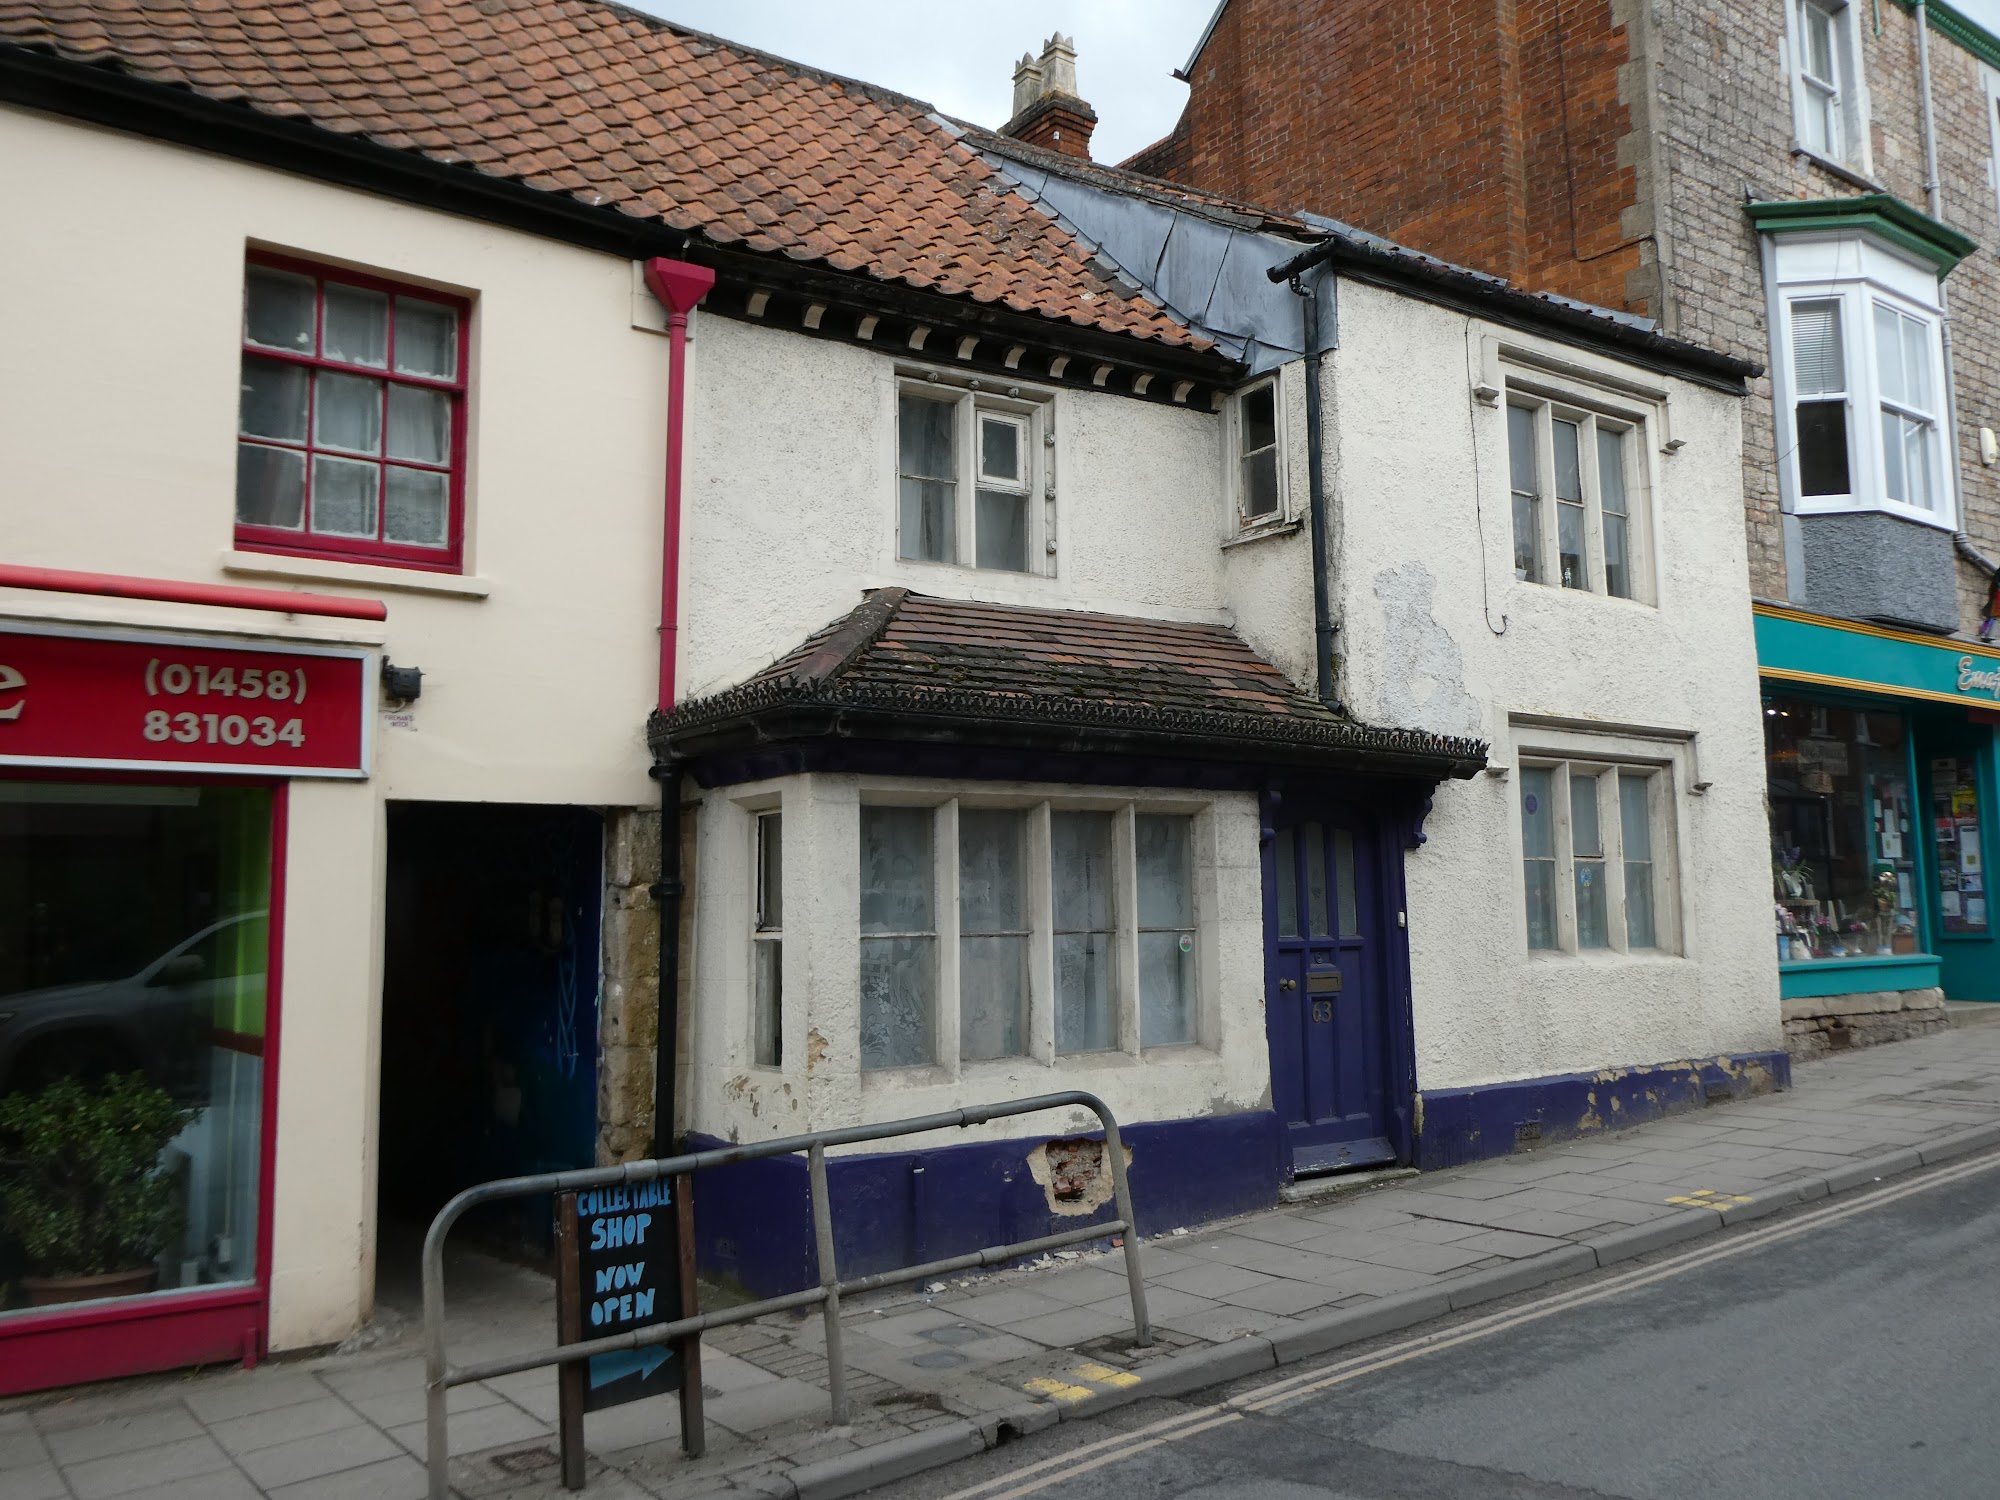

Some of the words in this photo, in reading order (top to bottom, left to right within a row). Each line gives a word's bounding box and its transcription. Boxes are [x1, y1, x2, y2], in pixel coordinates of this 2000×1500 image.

[147, 658, 307, 705] (01458)
[143, 710, 306, 748] 831034
[1313, 1001, 1332, 1023] 63
[577, 1178, 671, 1216] COLLECTABLE
[590, 1213, 652, 1250] SHOP
[596, 1261, 645, 1293] NOW
[591, 1288, 656, 1326] OPEN
